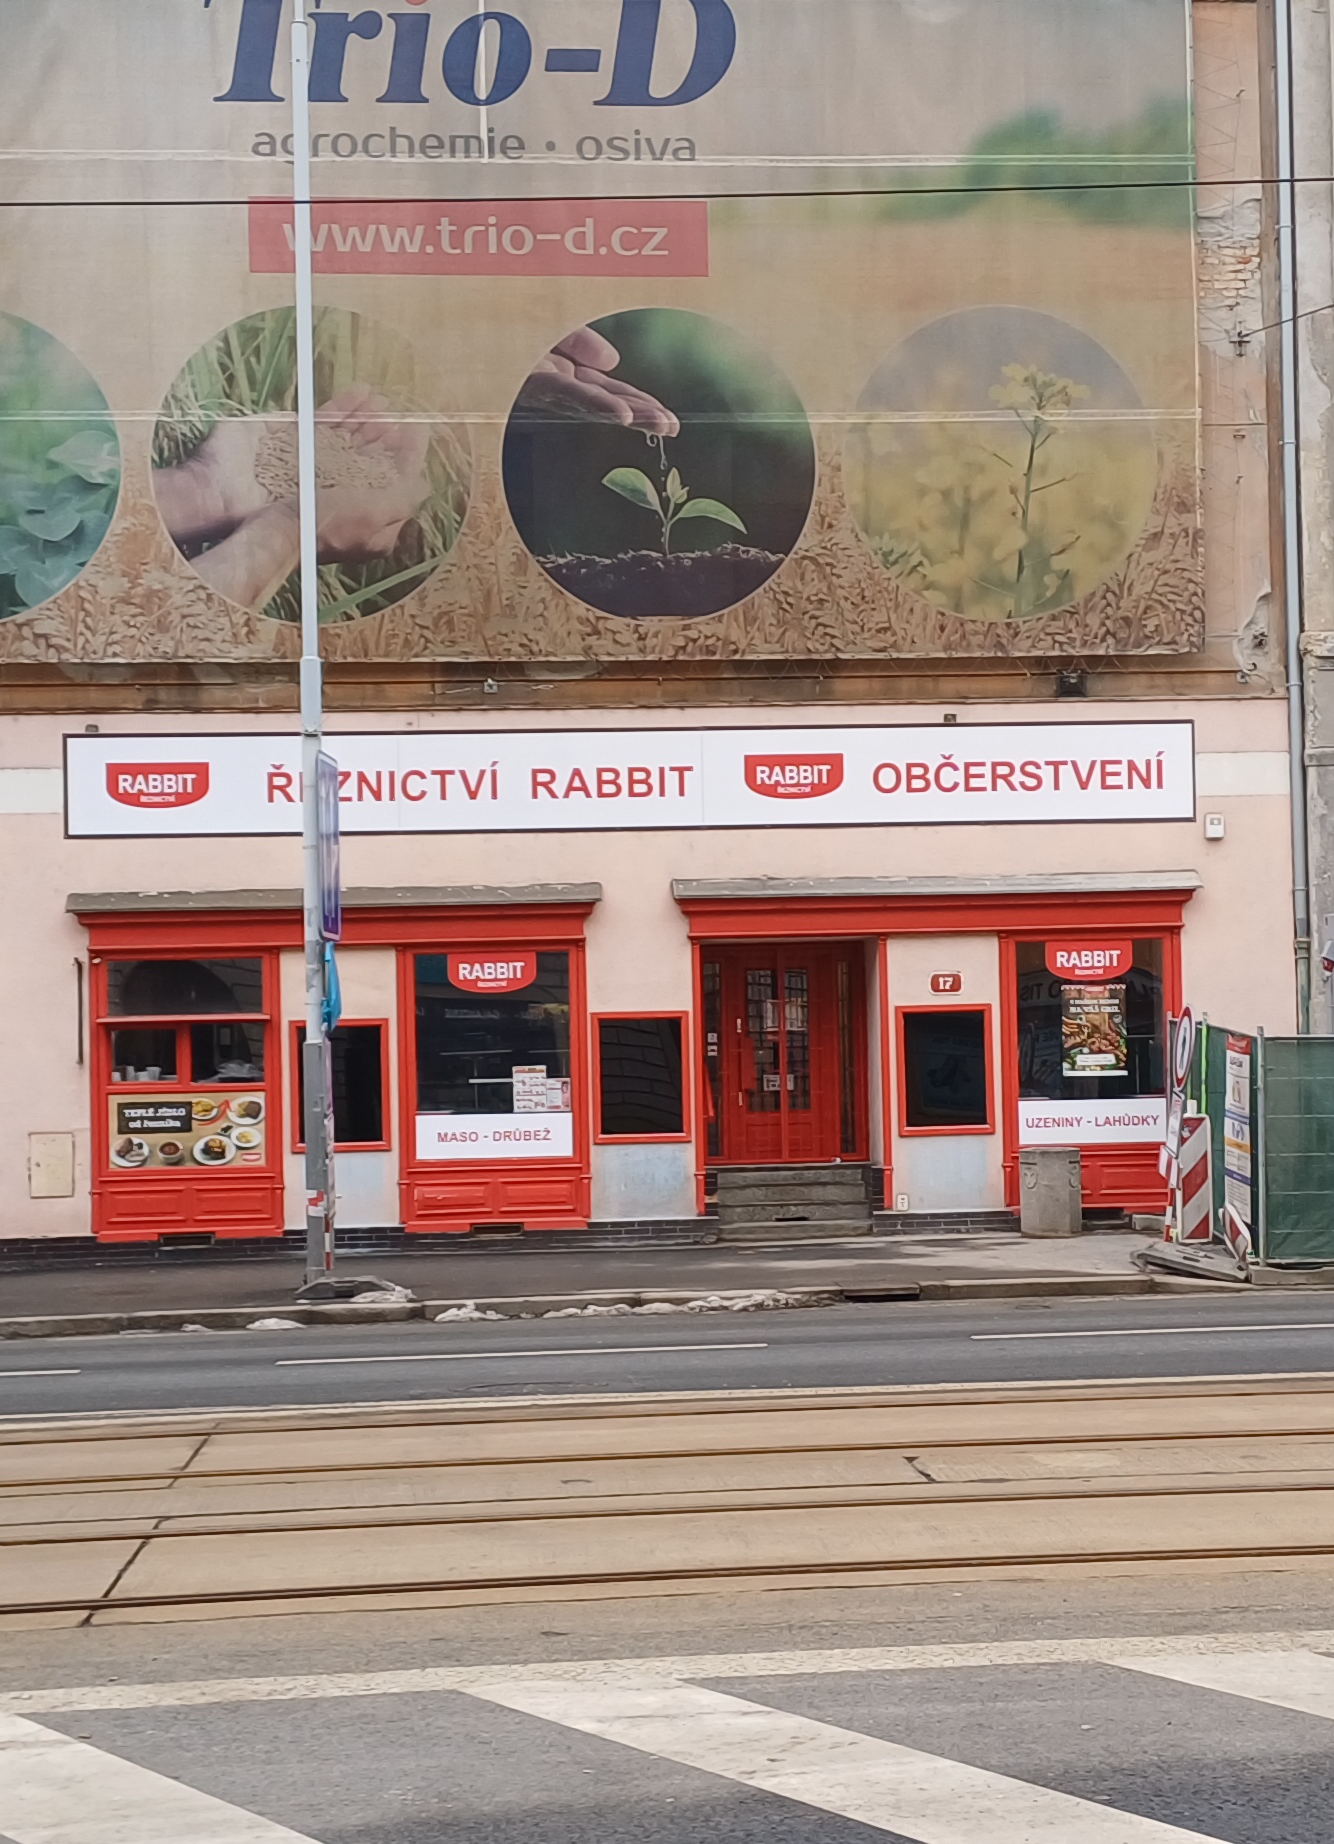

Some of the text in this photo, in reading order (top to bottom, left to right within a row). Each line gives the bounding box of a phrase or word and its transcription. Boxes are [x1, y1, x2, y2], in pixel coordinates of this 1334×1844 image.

[203, 0, 737, 107] Trio-D
[575, 128, 698, 162] osiva
[282, 216, 669, 256] www.trio-d.cz
[266, 761, 694, 803] ŘZNICTVÍ RABBIT
[756, 764, 832, 785] RABBIT
[872, 750, 1166, 794] OBČERSTVENÍ
[117, 773, 197, 794] RABBIT
[1055, 950, 1121, 968] RABBIT
[458, 962, 525, 980] RABBIT
[938, 976, 954, 990] 17
[1025, 1116, 1083, 1129] UZENINY
[1095, 1112, 1160, 1128] LAHŮDKY
[437, 1131, 479, 1143] MASO
[493, 1128, 553, 1142] DRŮBEŽ
